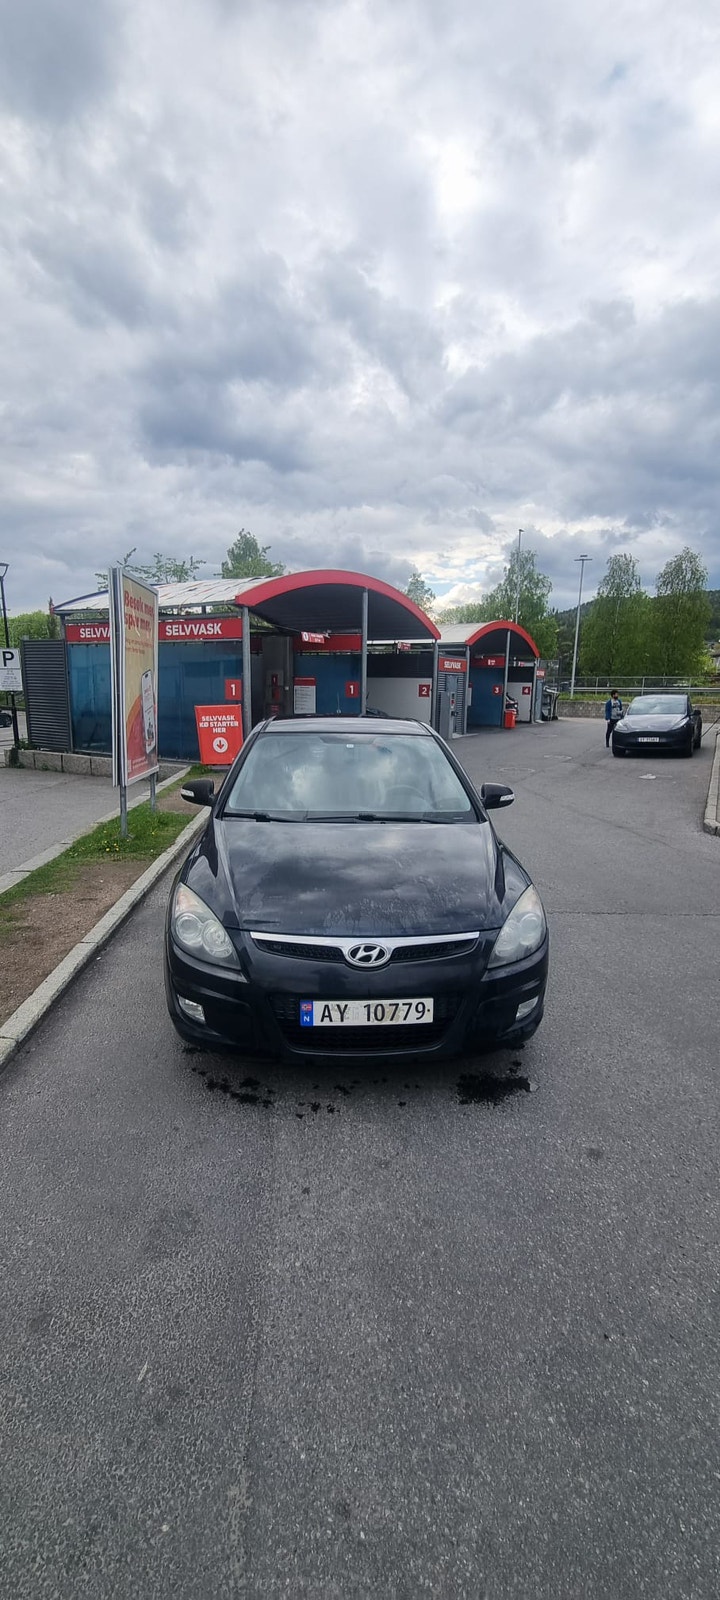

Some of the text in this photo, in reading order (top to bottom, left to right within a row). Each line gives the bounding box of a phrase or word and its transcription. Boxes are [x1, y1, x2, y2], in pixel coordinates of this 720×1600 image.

[80, 628, 110, 638] SELVV
[166, 623, 222, 636] SELVVASK
[2, 651, 14, 667] P
[230, 684, 236, 696] 1
[349, 685, 354, 694] 1
[422, 687, 427, 695] 2
[320, 1002, 426, 1022] AY 10779
